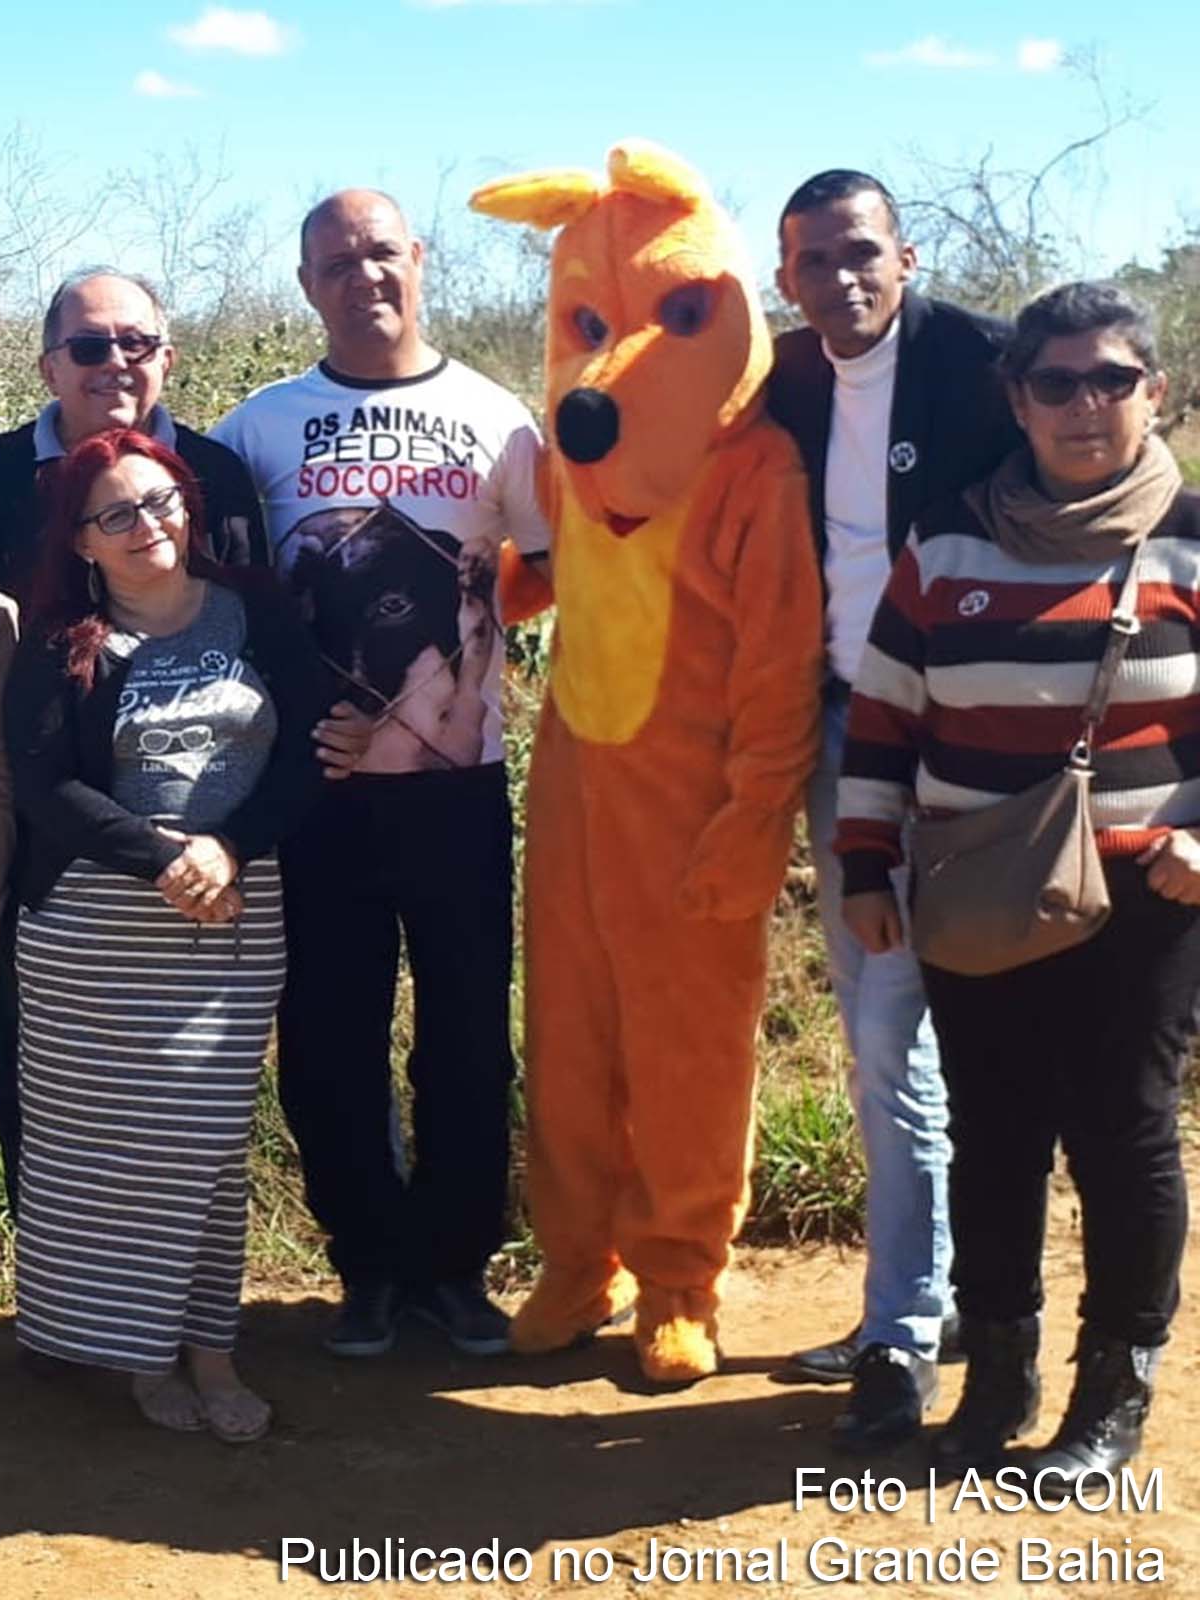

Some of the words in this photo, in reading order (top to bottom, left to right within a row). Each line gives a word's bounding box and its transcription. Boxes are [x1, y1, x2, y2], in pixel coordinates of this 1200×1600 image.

[303, 412, 340, 442] OS
[350, 406, 477, 447] ANIMAIS
[302, 433, 474, 467] PEDEM
